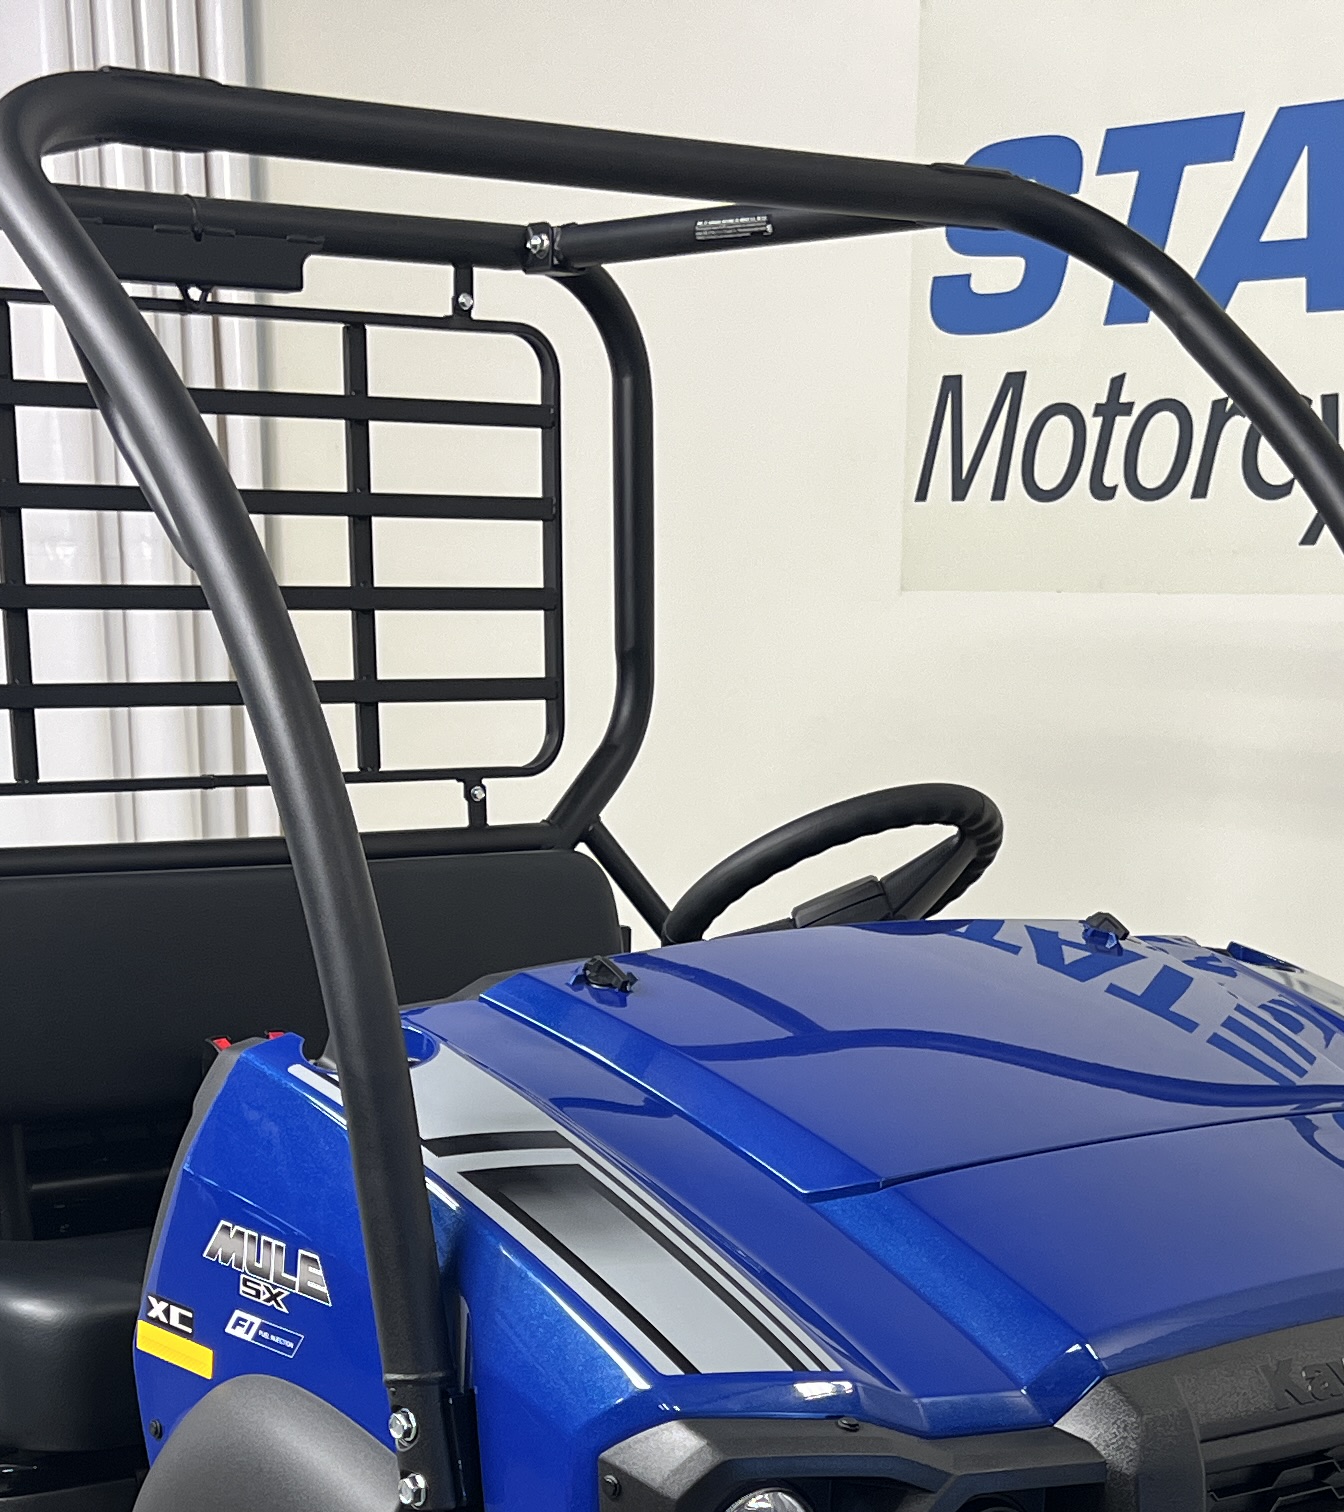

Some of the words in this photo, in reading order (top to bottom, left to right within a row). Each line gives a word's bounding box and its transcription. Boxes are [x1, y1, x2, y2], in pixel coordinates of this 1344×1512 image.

[203, 1219, 332, 1307] MULE
[240, 1273, 290, 1314] SX
[147, 1295, 193, 1334] XC
